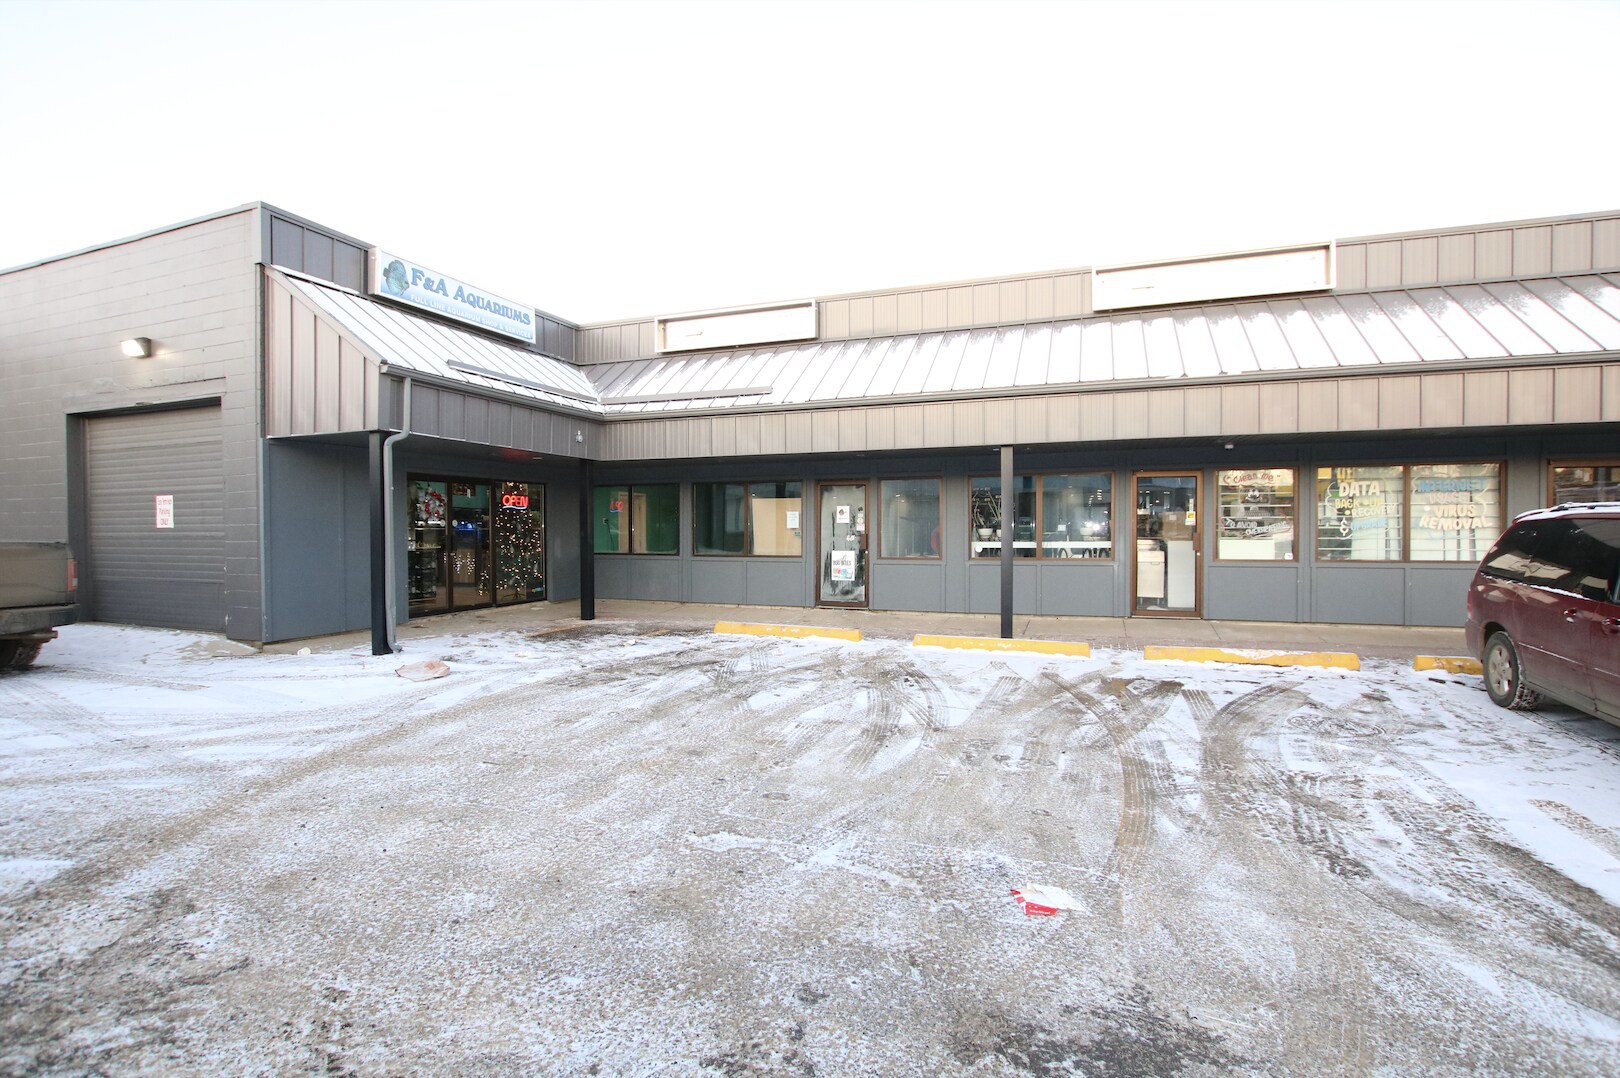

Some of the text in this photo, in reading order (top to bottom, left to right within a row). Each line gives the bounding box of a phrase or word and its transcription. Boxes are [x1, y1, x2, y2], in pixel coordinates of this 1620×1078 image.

[411, 267, 448, 297] F&A
[411, 295, 428, 307] FULL
[447, 305, 482, 323] AQUARIUM
[1339, 481, 1380, 497] DATA
[1418, 477, 1487, 492] INTERNET
[502, 495, 528, 507] OPEN
[1352, 503, 1398, 518] RECOVERY
[1434, 504, 1477, 517] VIRUS
[1419, 515, 1492, 530] REMOVAL
